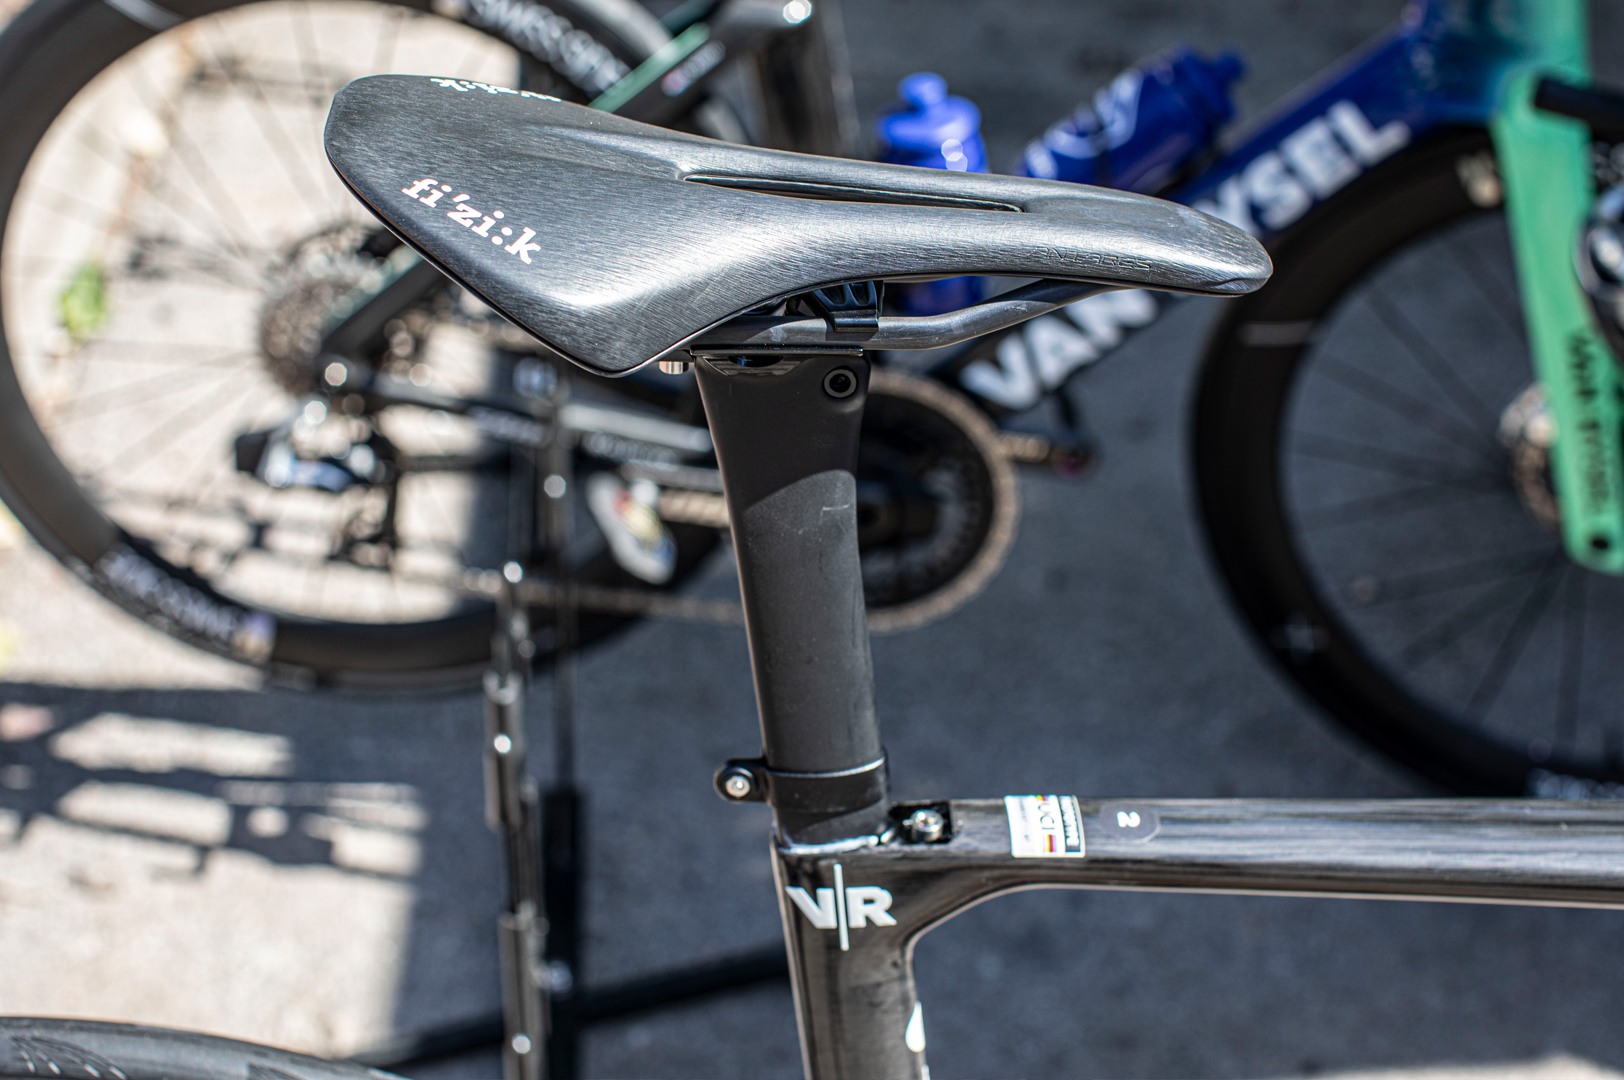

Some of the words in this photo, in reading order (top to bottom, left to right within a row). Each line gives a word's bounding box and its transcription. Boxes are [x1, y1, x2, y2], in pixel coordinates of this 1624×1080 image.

[1194, 99, 1412, 238] YSEL
[401, 178, 541, 264] fi'zi:k
[1028, 246, 1152, 271] ANTARES
[1037, 803, 1055, 830] UCI
[1116, 811, 1141, 828] 2
